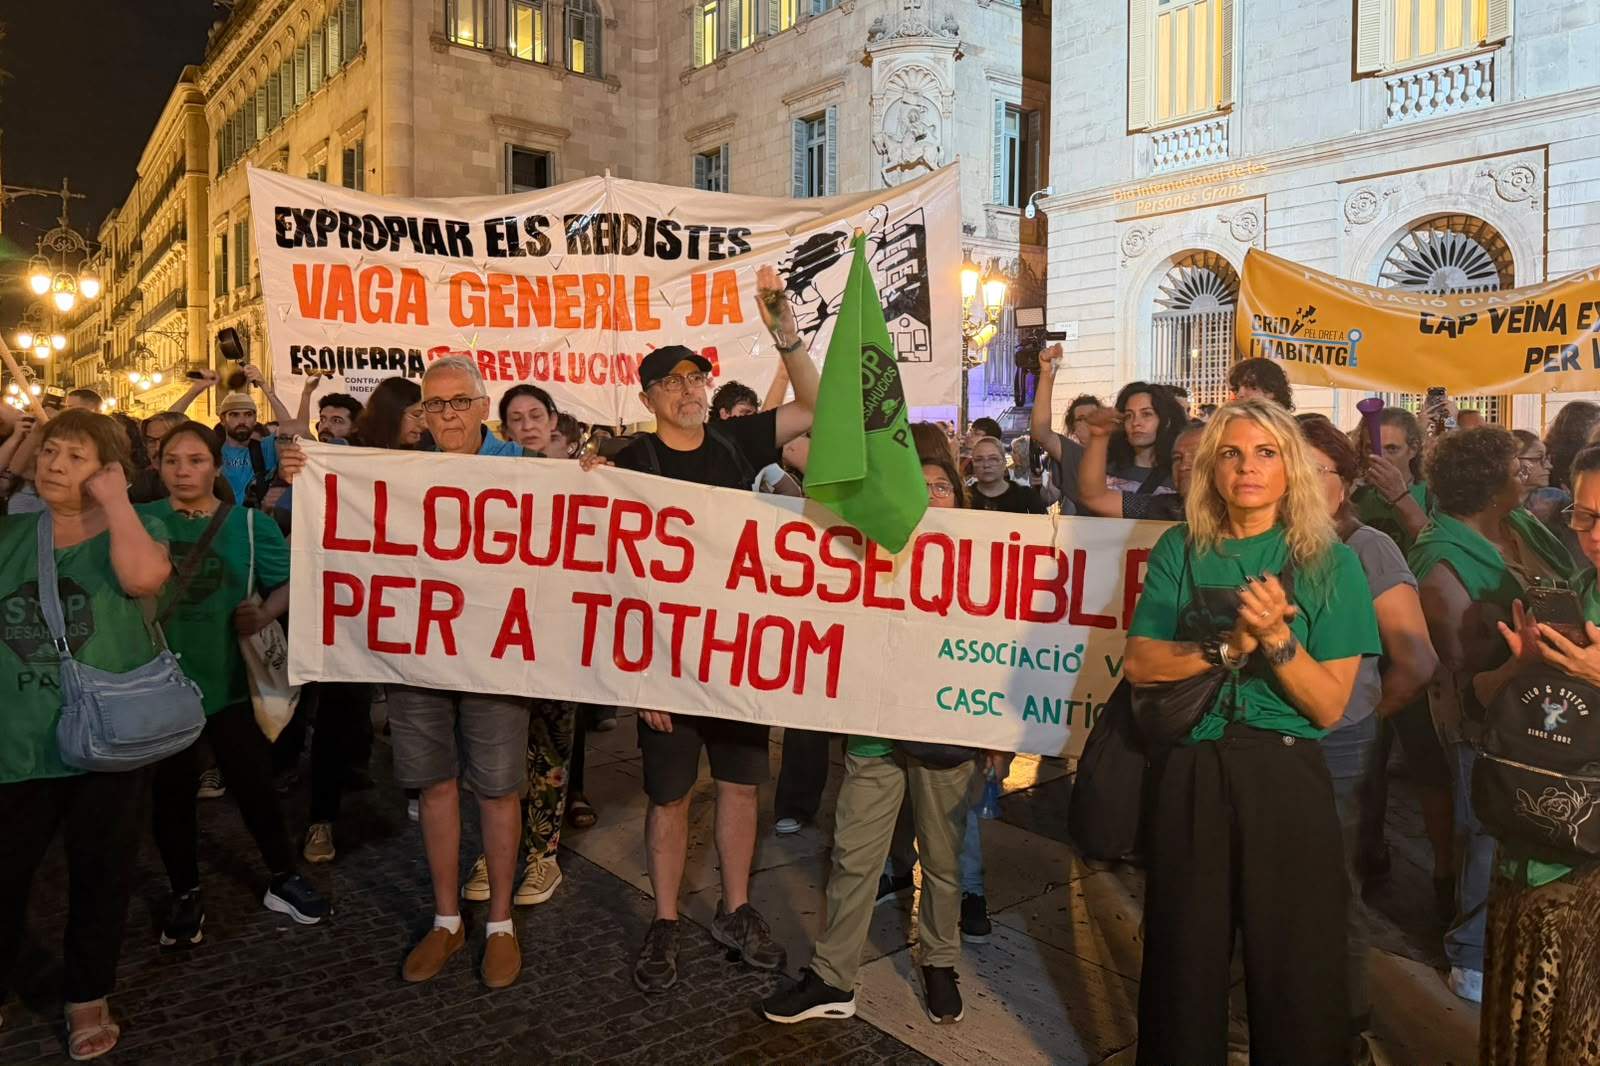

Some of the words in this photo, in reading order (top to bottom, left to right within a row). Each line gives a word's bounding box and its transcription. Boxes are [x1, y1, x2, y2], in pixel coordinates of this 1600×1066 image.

[1136, 191, 1198, 214] Persones
[1202, 182, 1247, 202] Grans
[274, 206, 474, 258] EXPROPIAR
[484, 214, 552, 258] ELS
[292, 263, 429, 326] VAGA
[685, 269, 744, 327] JA
[1419, 311, 1478, 338] CAP
[1488, 299, 1567, 335] VEÏNA
[1524, 343, 1581, 373] PER
[322, 473, 695, 584] LLOGUERS
[4, 594, 86, 624] STP
[4, 623, 89, 640] DESAHOS
[322, 570, 465, 656] PER
[490, 587, 536, 662] A
[571, 591, 845, 699] TOTHOM
[936, 685, 1004, 718] CASC
[1521, 687, 1540, 704] LILO
[1560, 688, 1589, 716] STITCH
